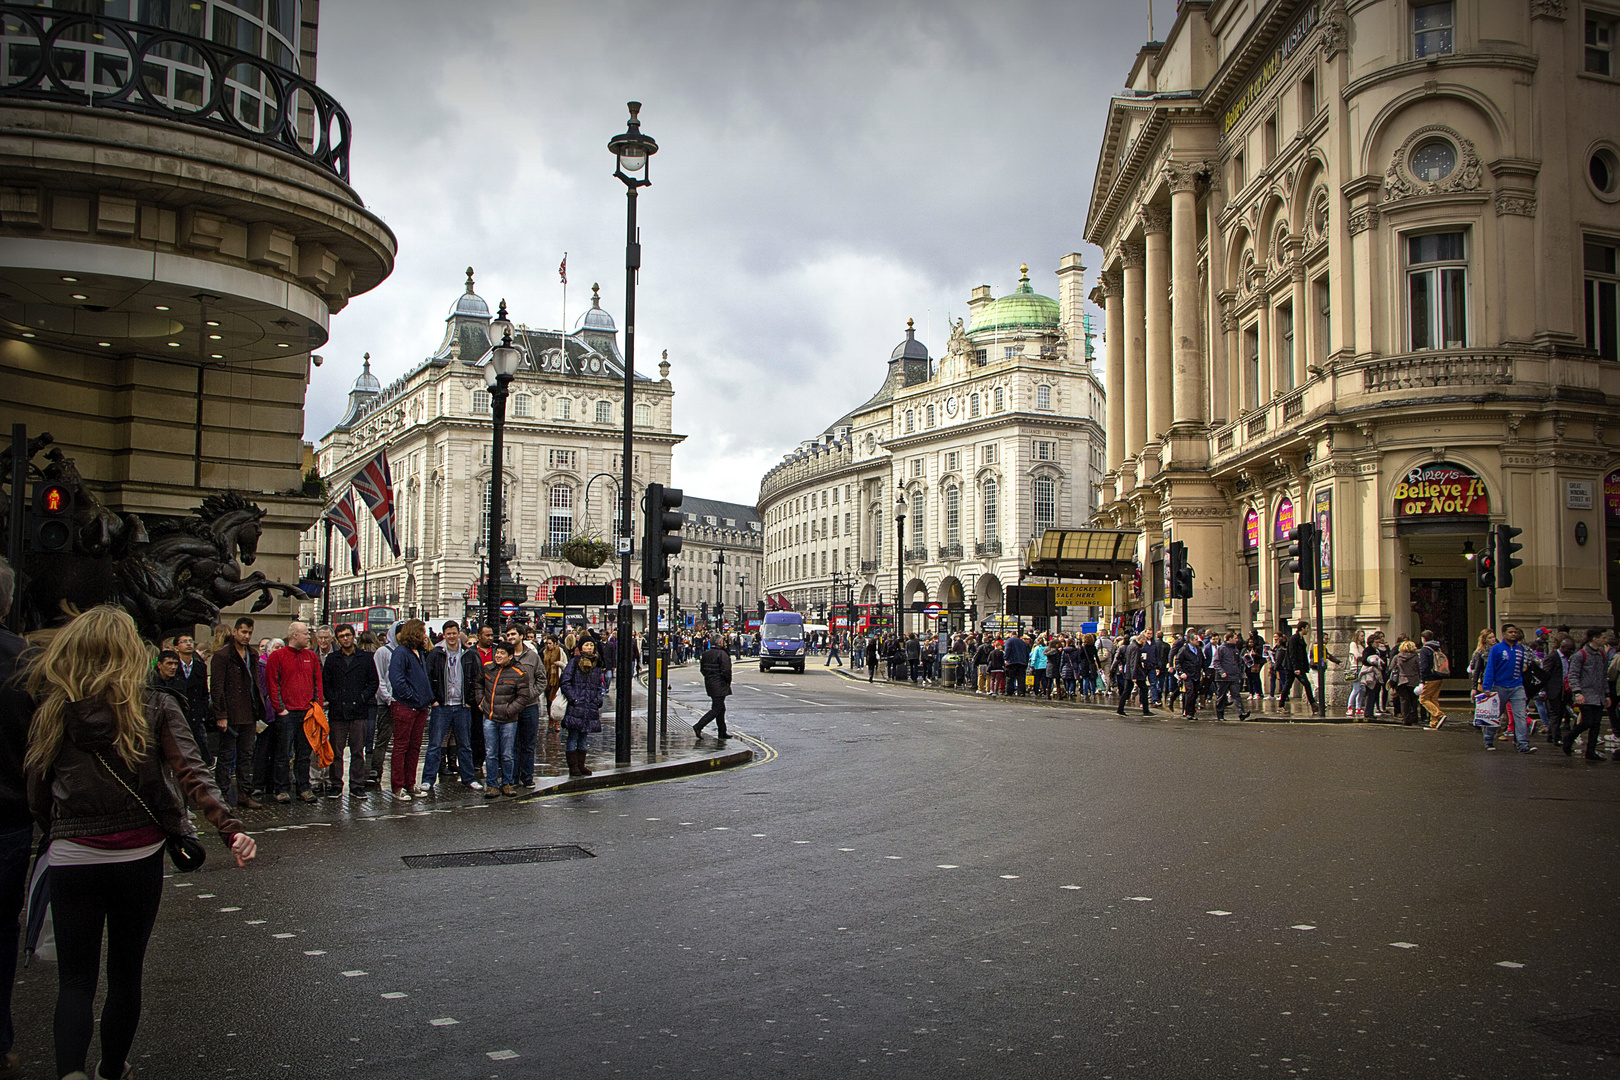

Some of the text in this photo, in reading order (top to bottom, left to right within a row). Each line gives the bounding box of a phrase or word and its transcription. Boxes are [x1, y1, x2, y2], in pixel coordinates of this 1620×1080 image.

[1225, 96, 1247, 132] Believe
[1281, 6, 1315, 61] MUSEUM
[1409, 468, 1468, 485] Ripley's
[1394, 479, 1485, 499] Believe It
[1405, 495, 1472, 515] or Not!
